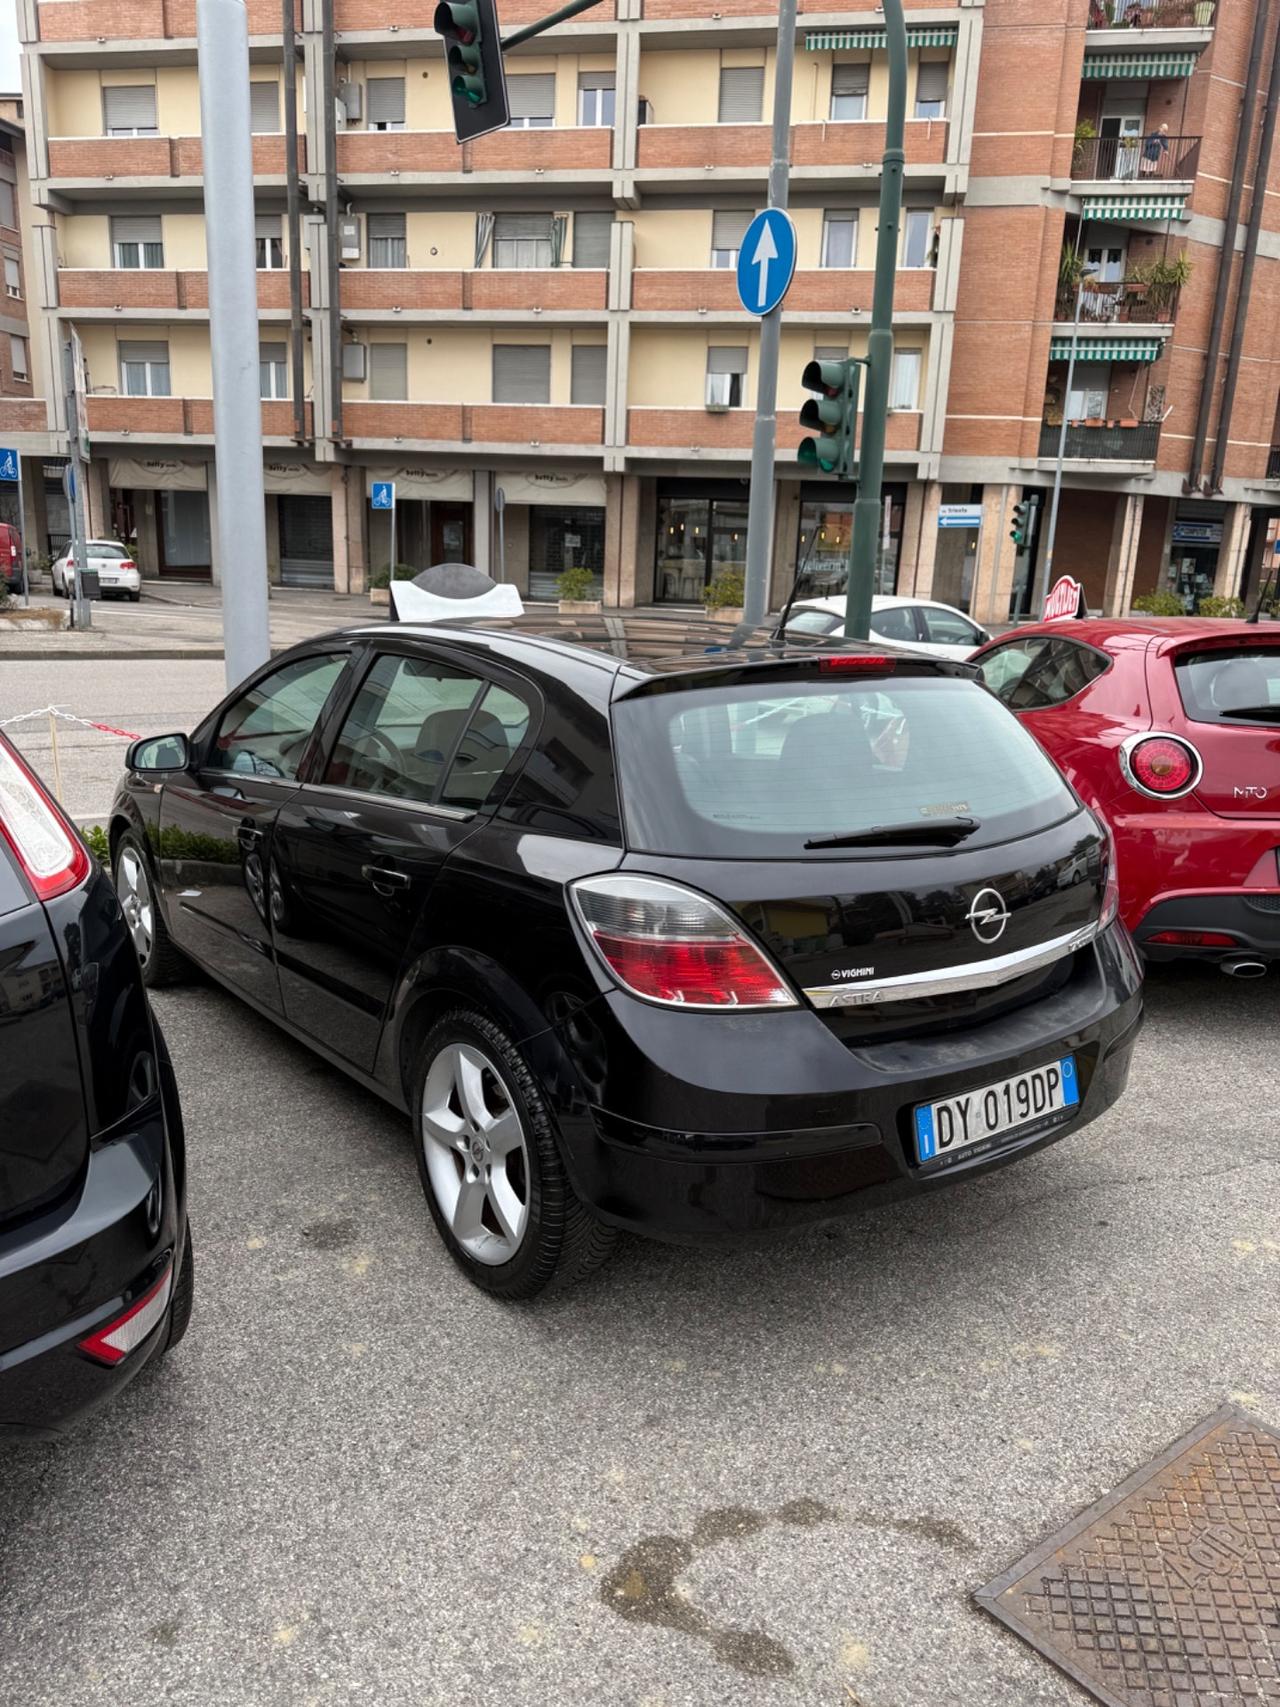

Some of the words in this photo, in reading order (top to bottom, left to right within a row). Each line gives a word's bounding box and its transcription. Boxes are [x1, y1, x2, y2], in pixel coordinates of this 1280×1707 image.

[841, 966, 875, 978] VIGHINI
[829, 991, 881, 1007] ASTRA
[936, 1097, 970, 1149] DY
[984, 1067, 1060, 1131] 019DP
